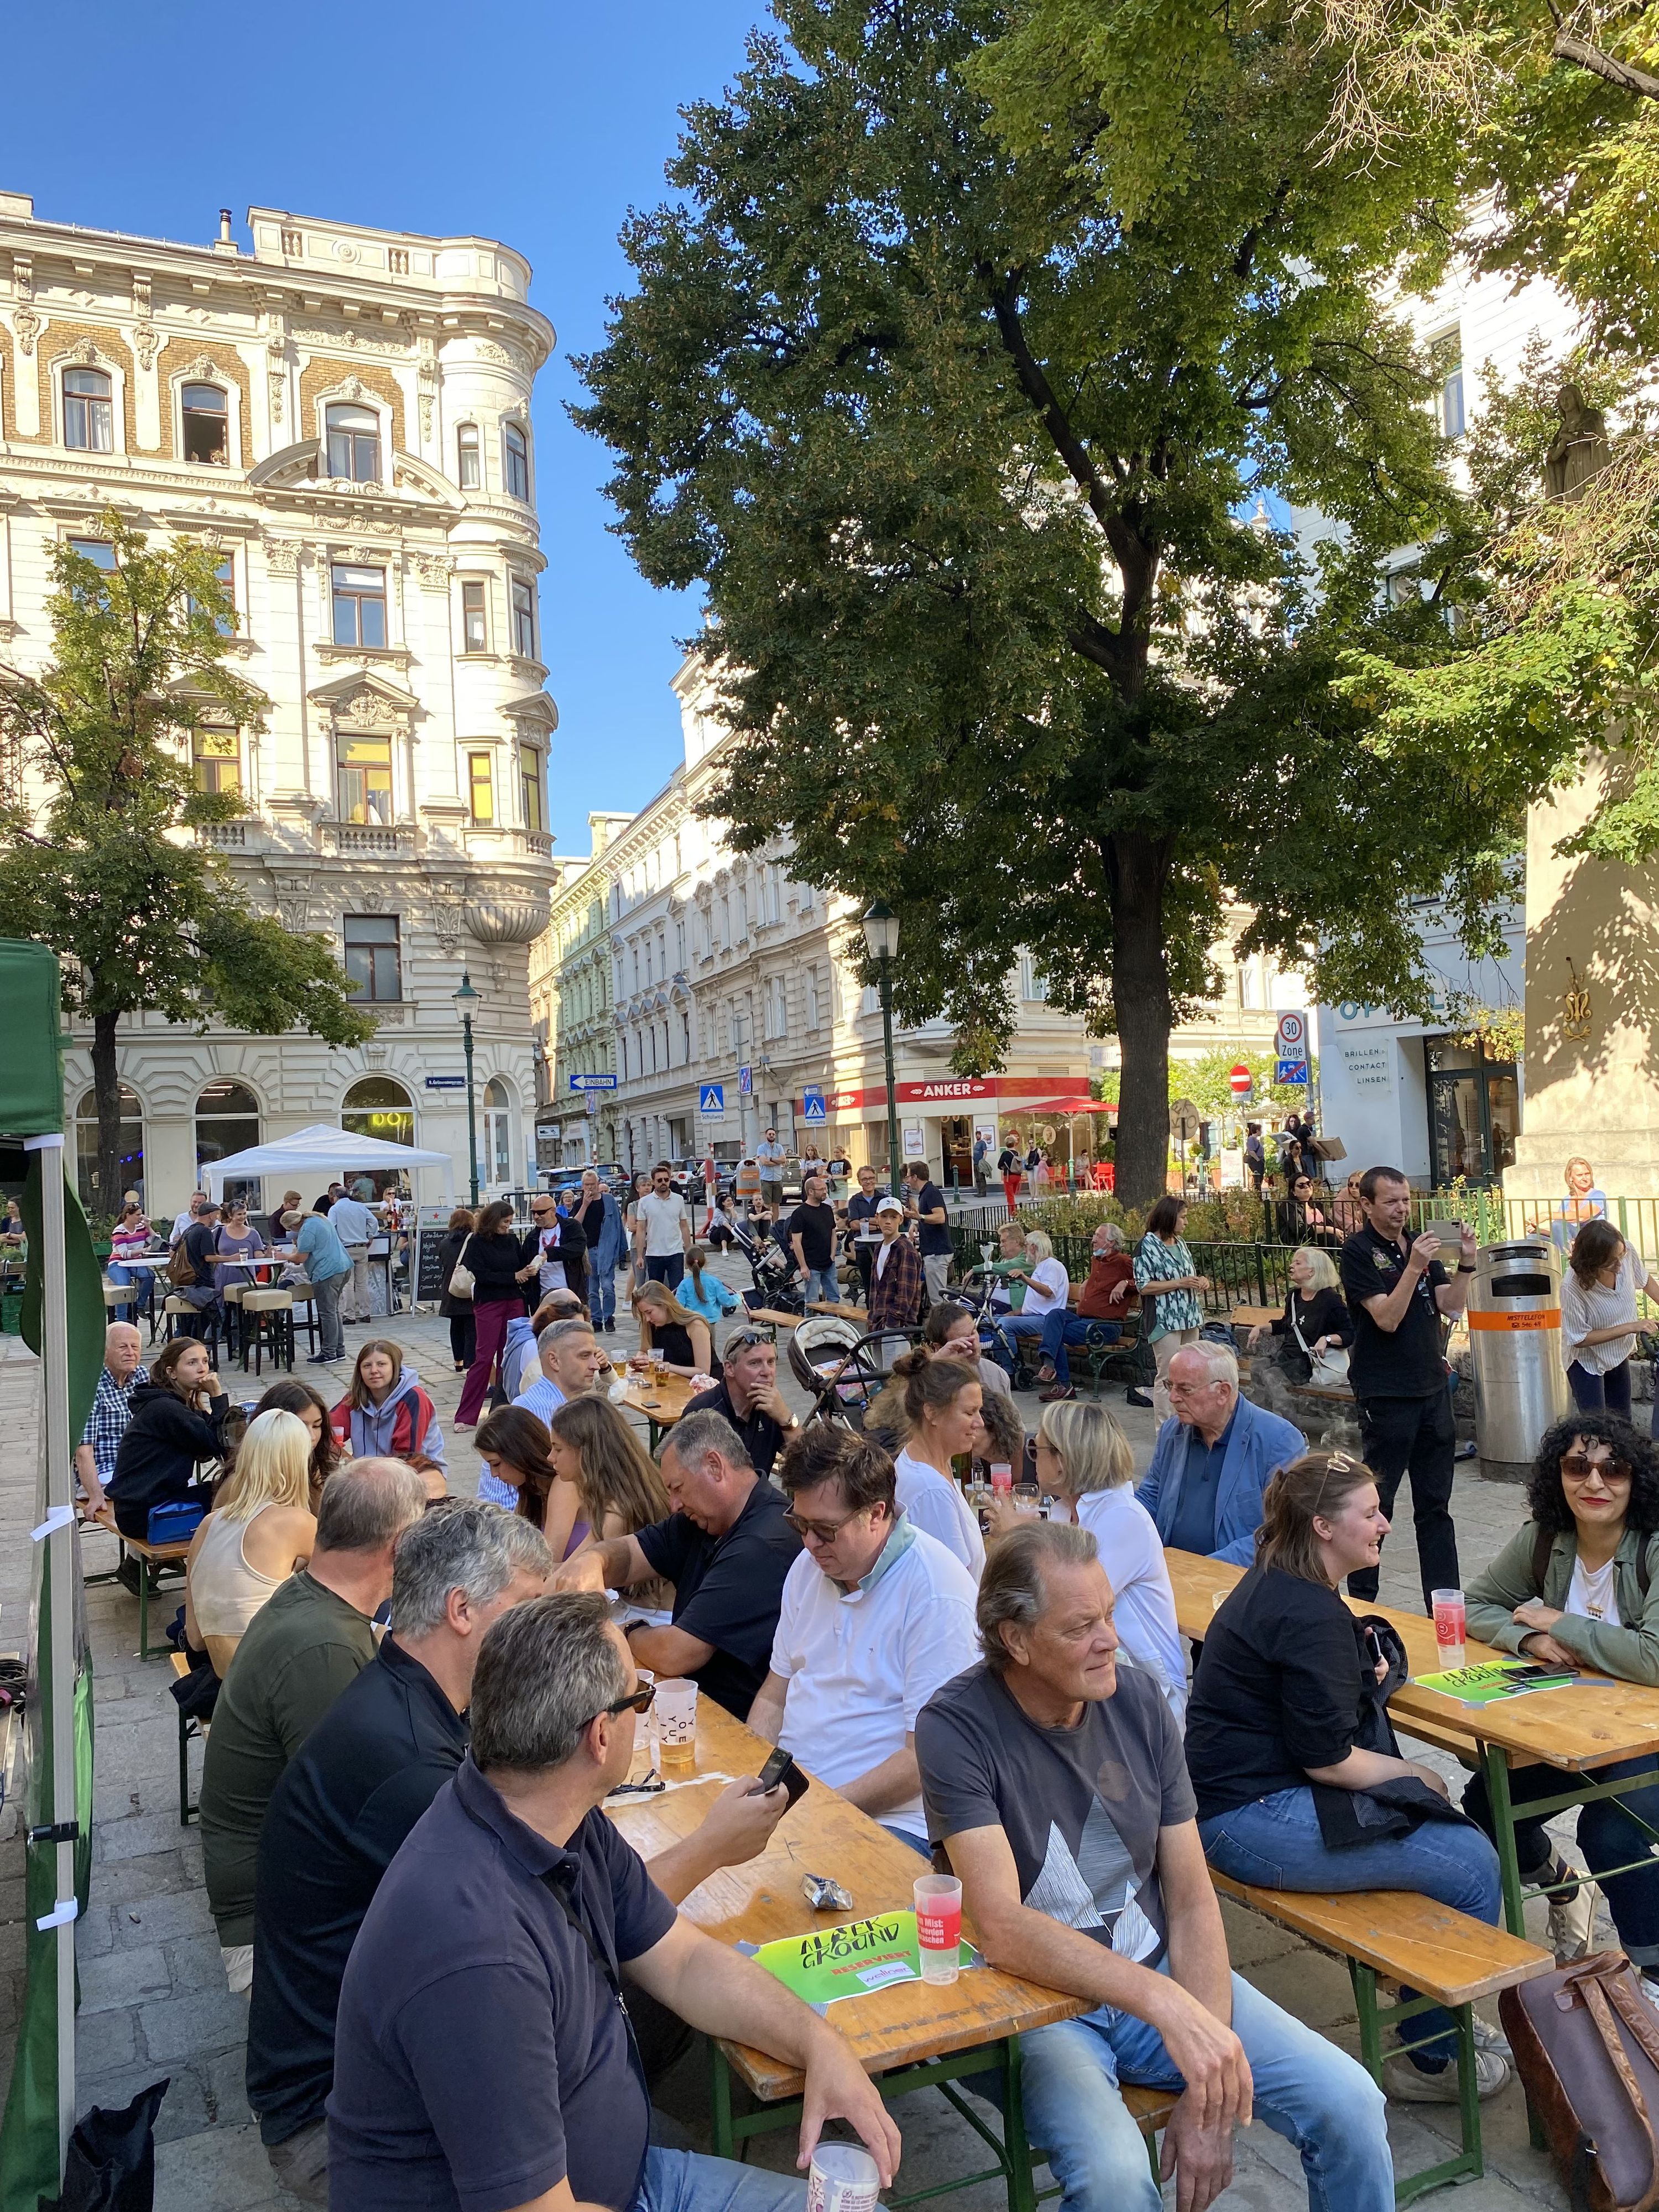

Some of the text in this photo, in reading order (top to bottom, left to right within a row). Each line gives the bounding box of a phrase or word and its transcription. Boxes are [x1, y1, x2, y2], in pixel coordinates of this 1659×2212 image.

[1285, 1022, 1297, 1035] 30
[1282, 1045, 1302, 1056] Zone
[1344, 1049, 1379, 1057] BRILLEN
[1349, 1062, 1386, 1071] CONTACT
[923, 1083, 971, 1097] ANKER
[924, 1918, 943, 1928] Mist:
[803, 1923, 899, 1969] GROUND
[831, 1950, 912, 1975] RESERVIERT
[862, 1966, 910, 1983] wallner
